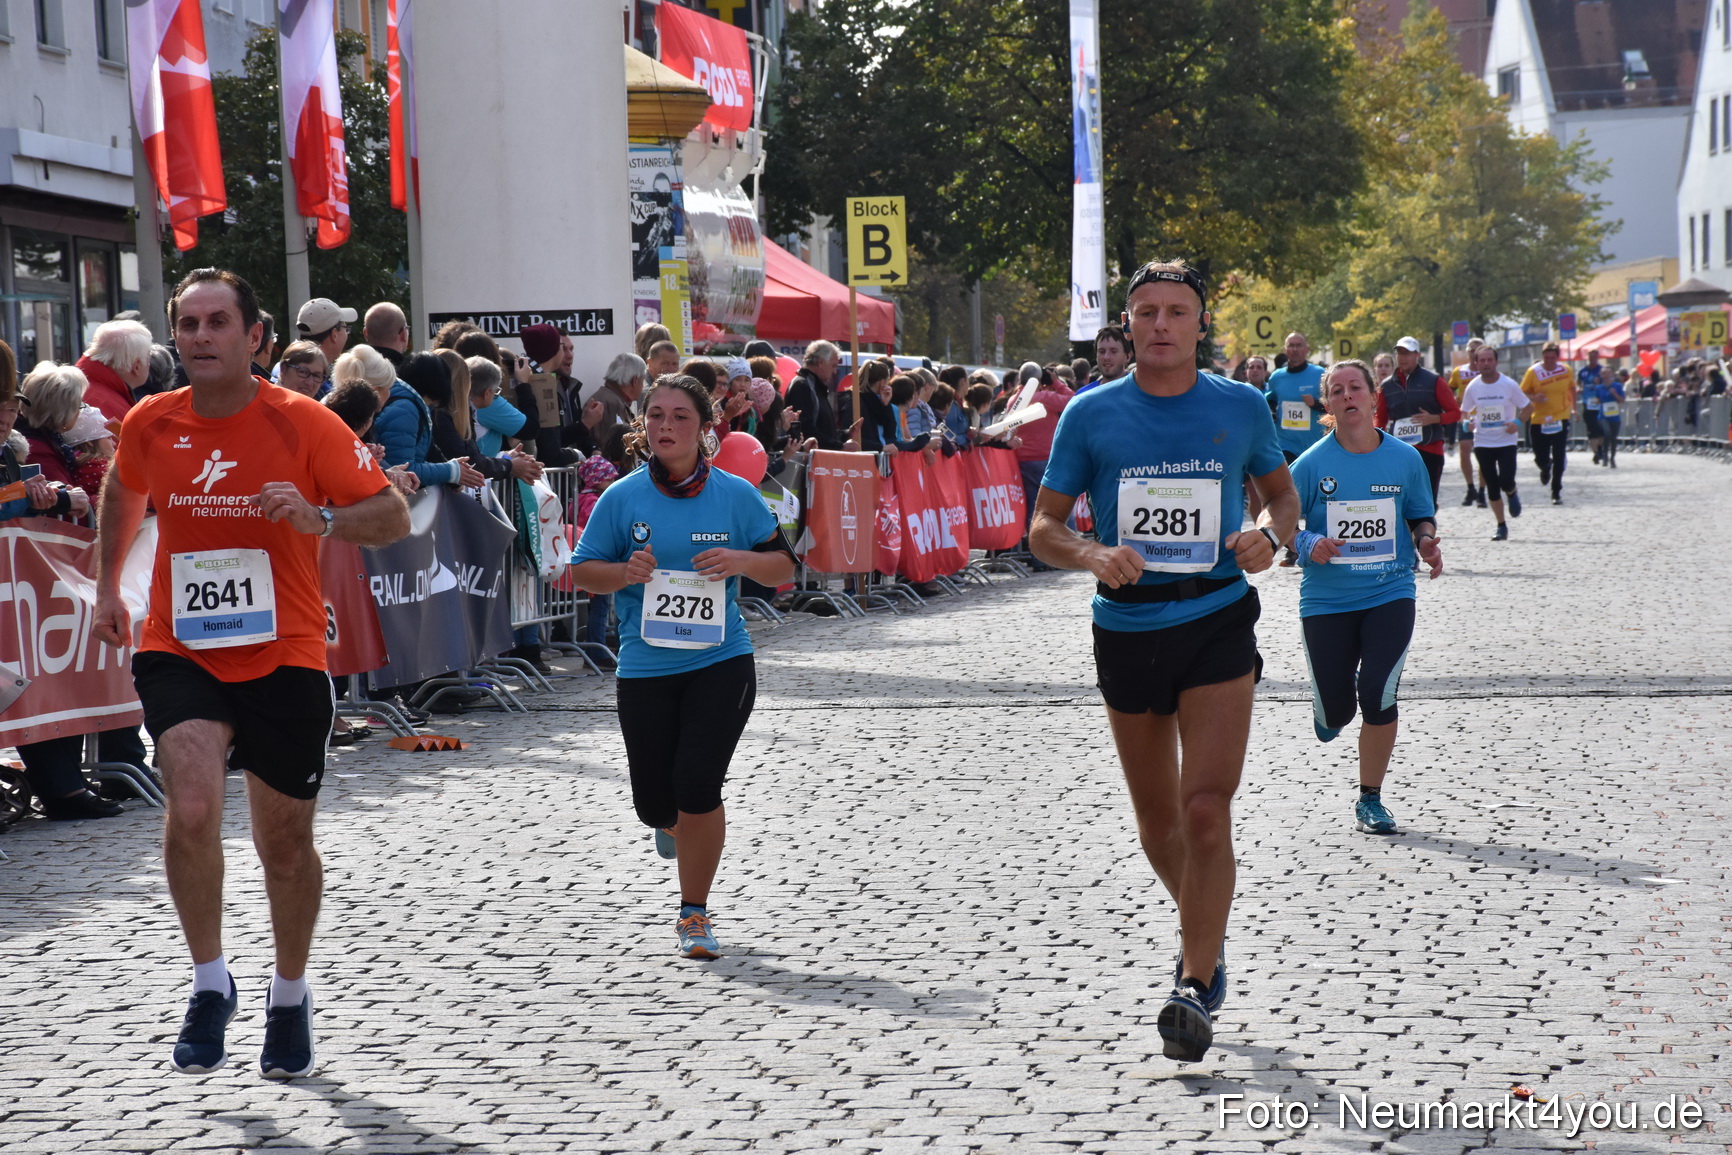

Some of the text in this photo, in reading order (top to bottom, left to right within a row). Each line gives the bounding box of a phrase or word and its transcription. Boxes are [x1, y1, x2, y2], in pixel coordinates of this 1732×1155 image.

[644, 203, 657, 214] CUP
[854, 200, 899, 217] Block
[863, 224, 892, 266] B
[1251, 303, 1277, 313] Block
[1255, 316, 1273, 340] C
[1711, 321, 1725, 339] D
[1339, 339, 1353, 357] D
[1288, 410, 1304, 420] 164
[1481, 412, 1502, 422] 2458
[1397, 425, 1419, 436] 2600
[1120, 459, 1224, 478] www.hasit.de
[1157, 488, 1192, 496] BOCK
[1371, 485, 1401, 493] BOCK
[168, 493, 250, 508] funrunners
[192, 505, 263, 517] neumarkt
[1132, 507, 1201, 536] 2381
[1337, 518, 1387, 539] 2268
[691, 533, 729, 541] BOCK
[1145, 545, 1192, 558] Wolfgang
[1349, 545, 1376, 553] Daniela
[204, 558, 240, 568] BOCK
[1351, 562, 1385, 571] Stadtlauf
[677, 578, 705, 586] BOCK
[185, 577, 254, 612] 2641
[655, 594, 714, 620] 2378
[203, 618, 243, 632] Homaid
[675, 626, 692, 635] Lisa
